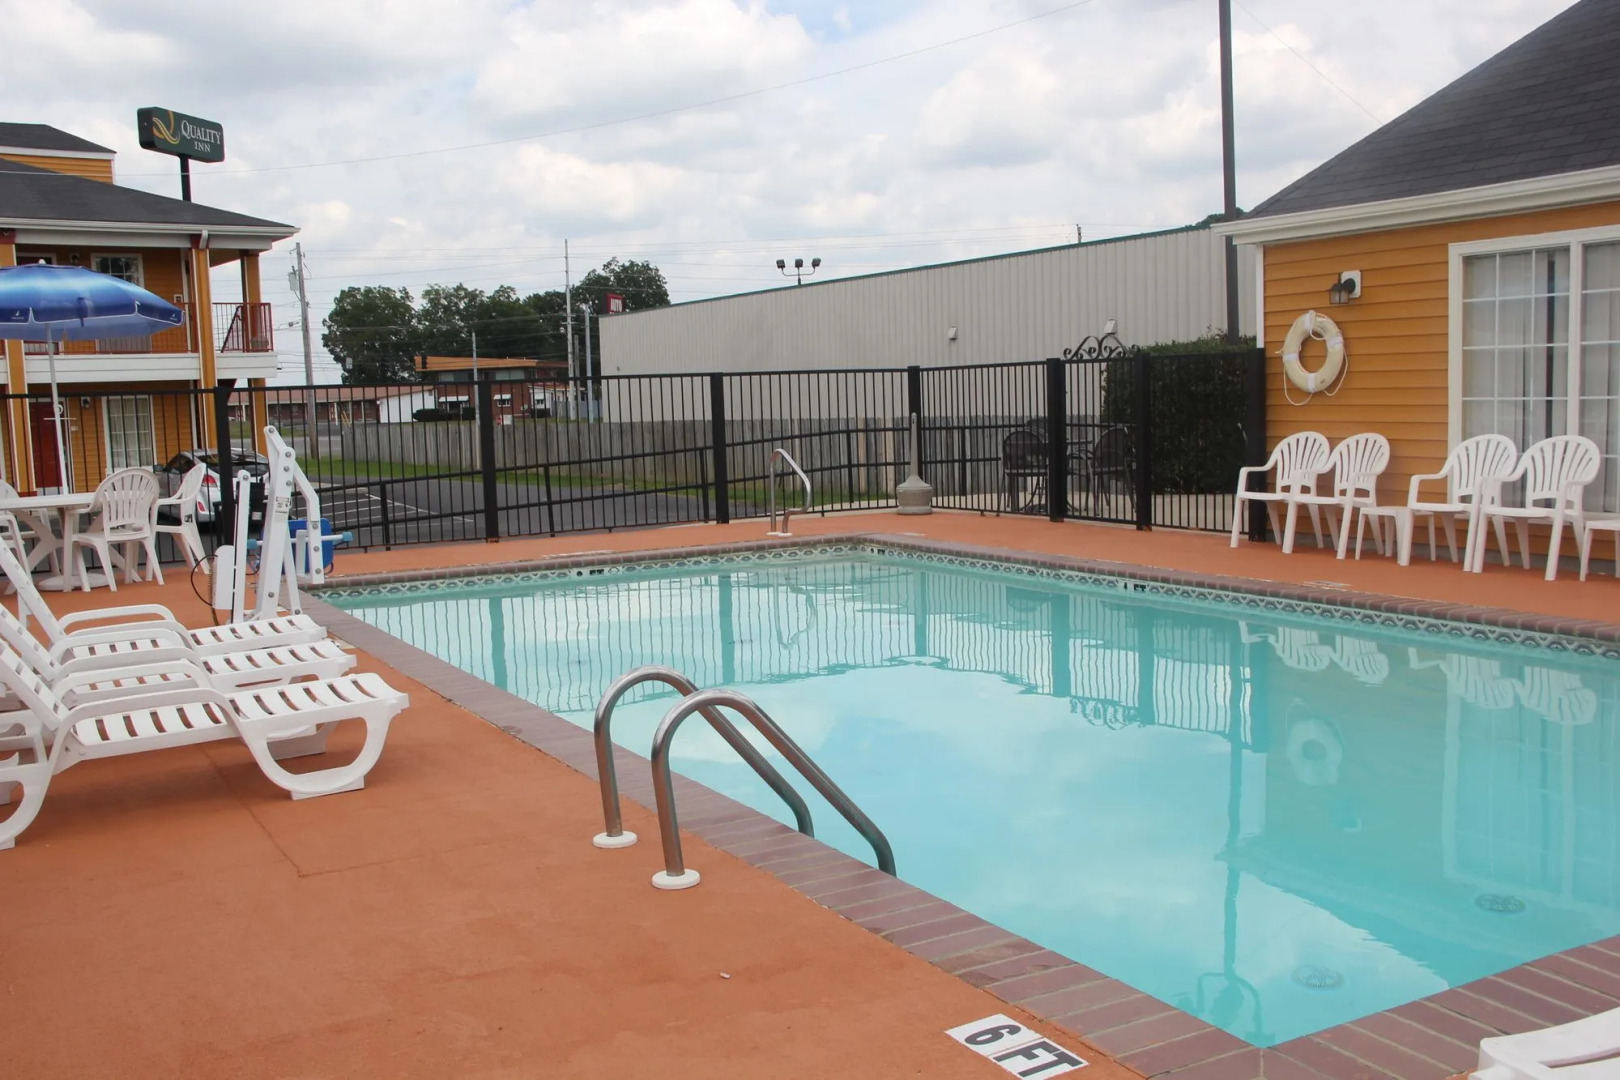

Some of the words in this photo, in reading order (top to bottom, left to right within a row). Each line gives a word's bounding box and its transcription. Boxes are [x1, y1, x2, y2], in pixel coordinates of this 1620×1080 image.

[181, 120, 221, 145] QUALITY
[194, 141, 211, 153] INN
[964, 1024, 1022, 1046] 6
[993, 1040, 1084, 1078] FT
